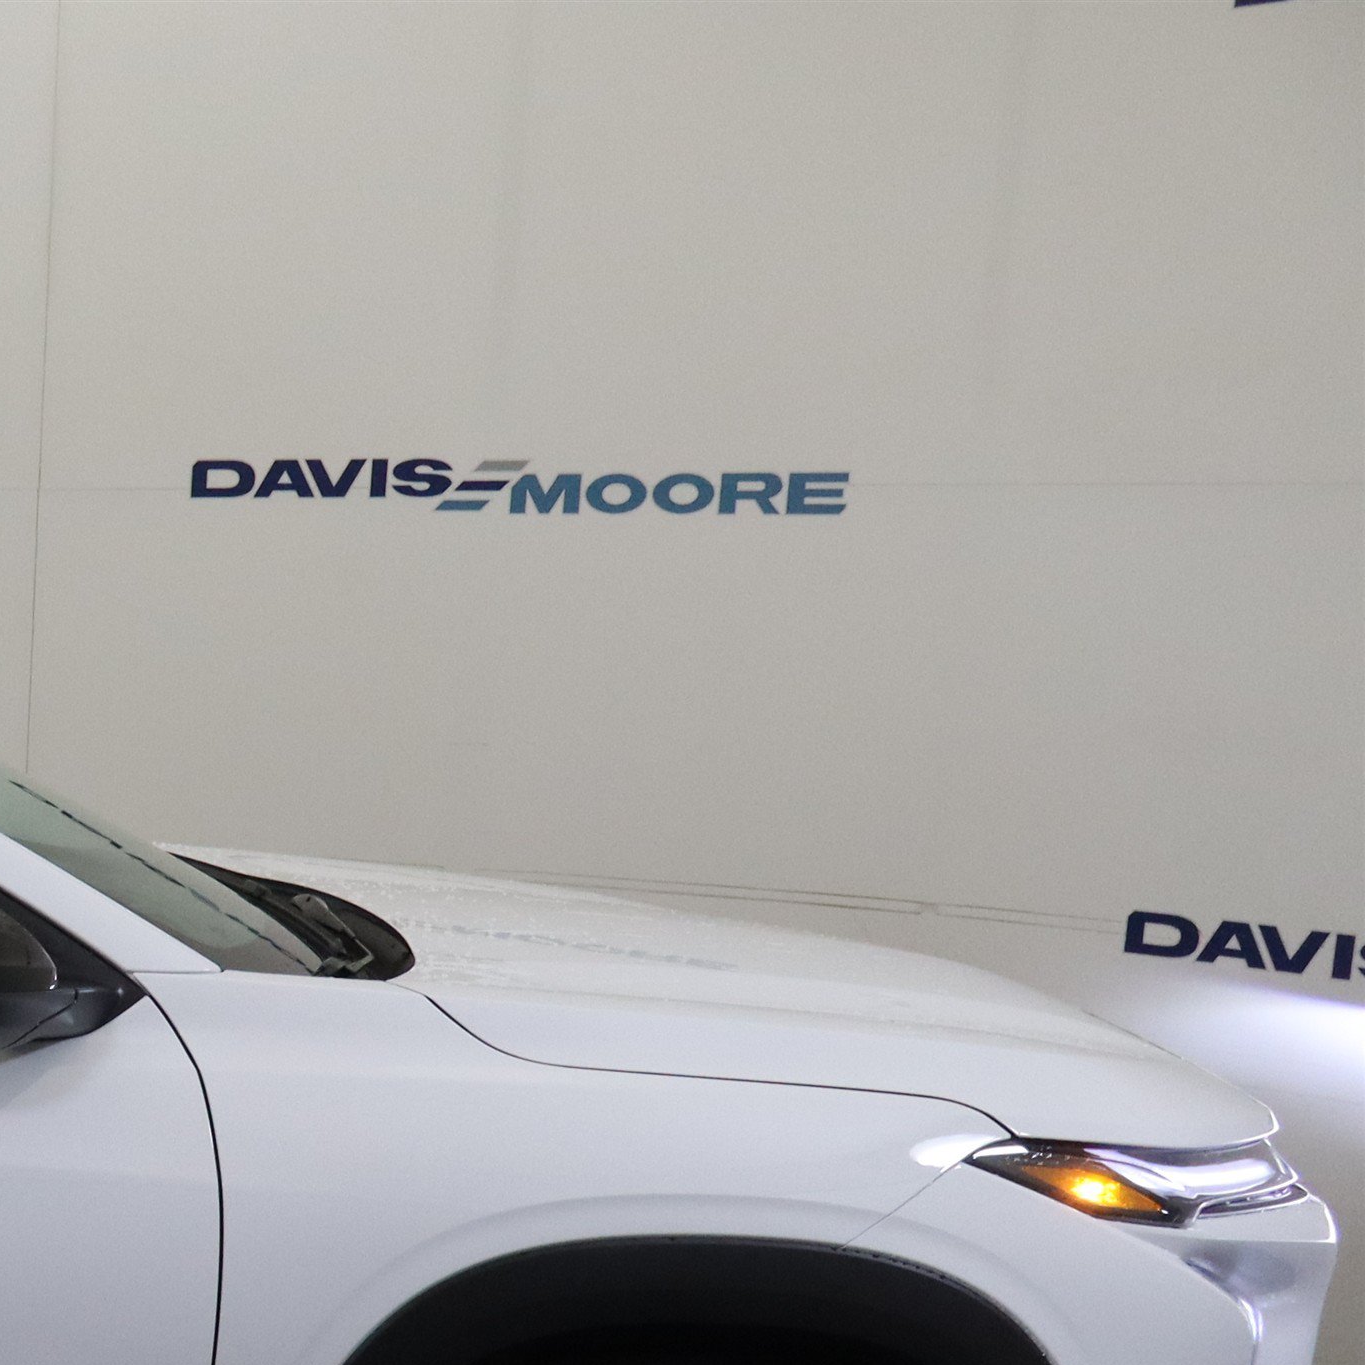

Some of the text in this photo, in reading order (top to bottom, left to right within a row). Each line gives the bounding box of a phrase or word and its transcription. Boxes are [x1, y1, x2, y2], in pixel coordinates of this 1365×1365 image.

[189, 457, 851, 515] DAVIS MOORE
[1124, 910, 1365, 981] DAVI
